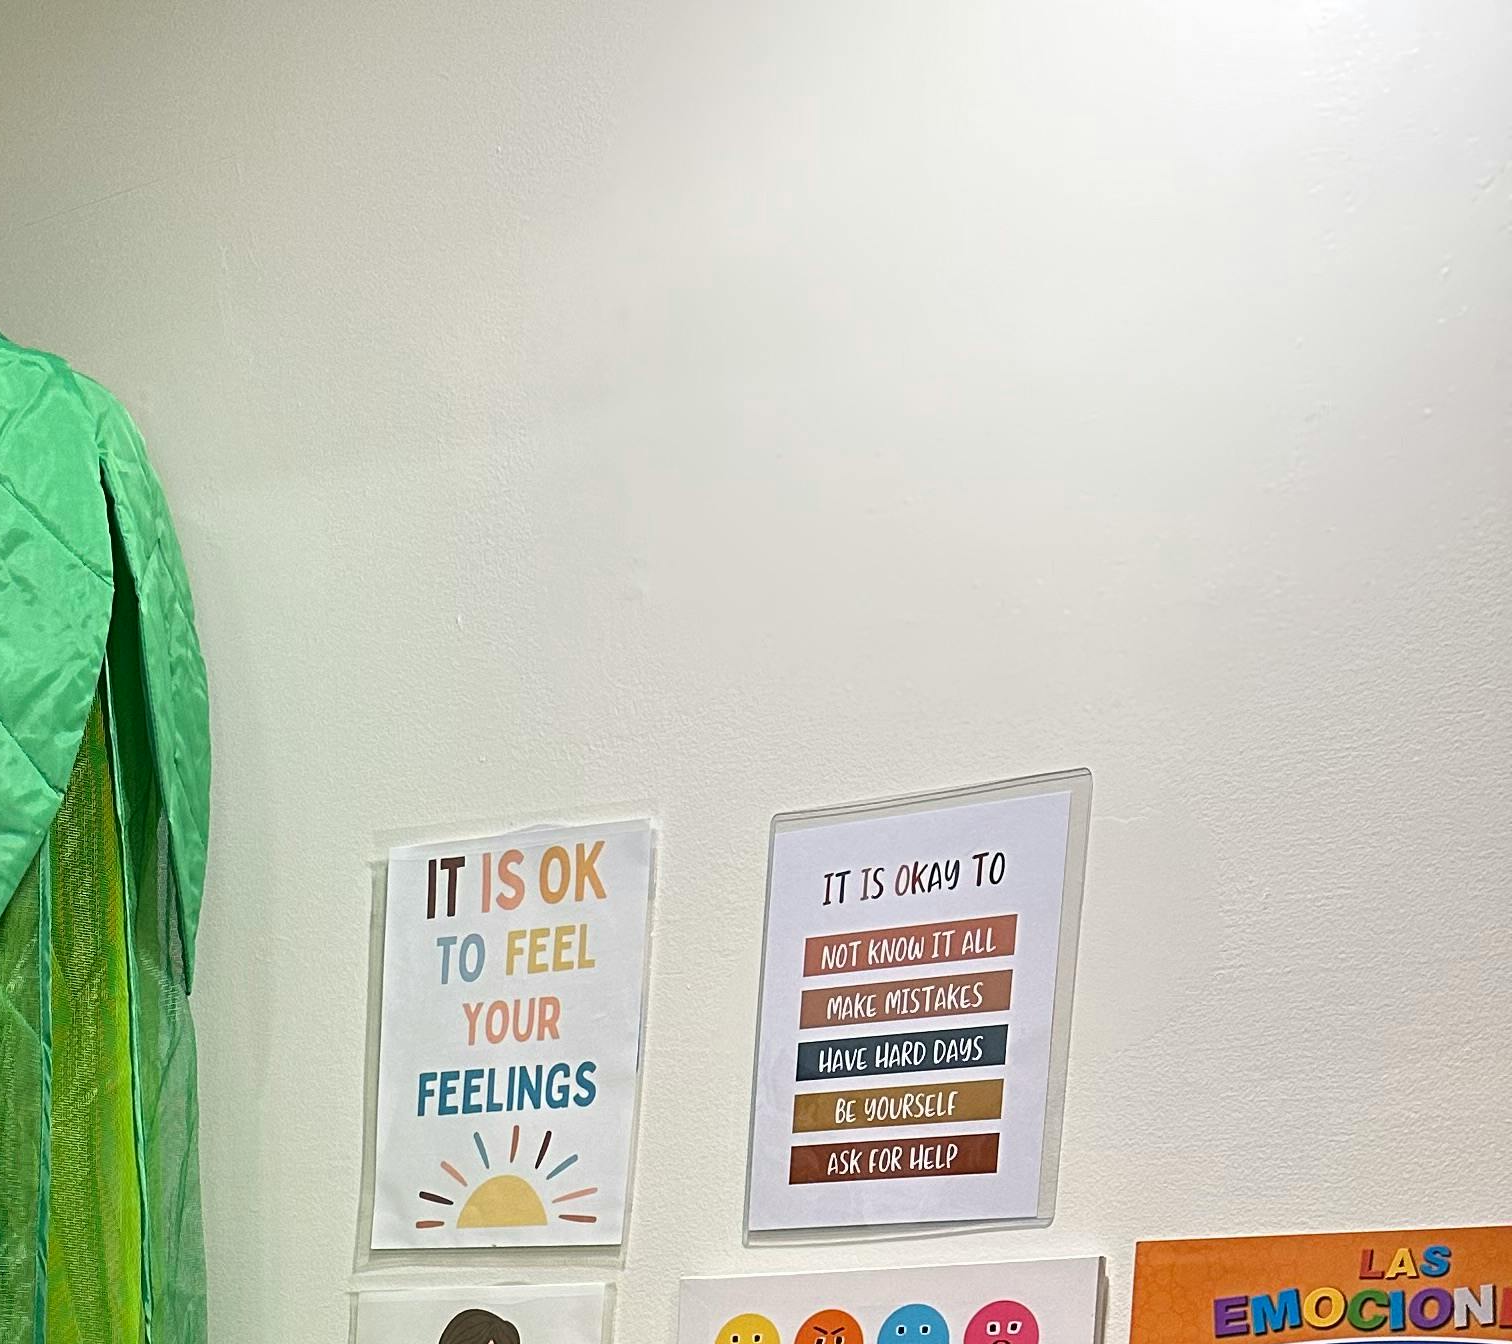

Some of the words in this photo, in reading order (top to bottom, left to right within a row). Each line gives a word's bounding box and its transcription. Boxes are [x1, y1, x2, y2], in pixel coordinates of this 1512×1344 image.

[426, 855, 466, 920] IT
[480, 849, 526, 914] IS
[538, 839, 608, 906] OK
[821, 869, 852, 906] IT
[860, 866, 885, 902] IS
[894, 857, 961, 897] OKAY
[971, 851, 1006, 887] TO
[436, 932, 486, 985] TO
[504, 923, 597, 977] FEEL
[820, 940, 862, 970] NOT
[867, 936, 926, 966] KNOW
[930, 930, 957, 960] IT
[961, 926, 997, 955] ALL
[462, 995, 561, 1047] YOUR
[826, 992, 878, 1021] MAKE
[884, 981, 985, 1016] MISTAKES
[818, 1045, 868, 1074] HAVE
[874, 1040, 927, 1069] HARD
[932, 1035, 985, 1063] DAYS
[416, 1060, 598, 1118] FEELINGS
[834, 1097, 857, 1124] BE
[863, 1090, 959, 1121] YOURSELF
[826, 1148, 863, 1176] ASK
[868, 1145, 903, 1172] FOR
[909, 1142, 959, 1170] HELP
[1358, 1244, 1453, 1282] LAS
